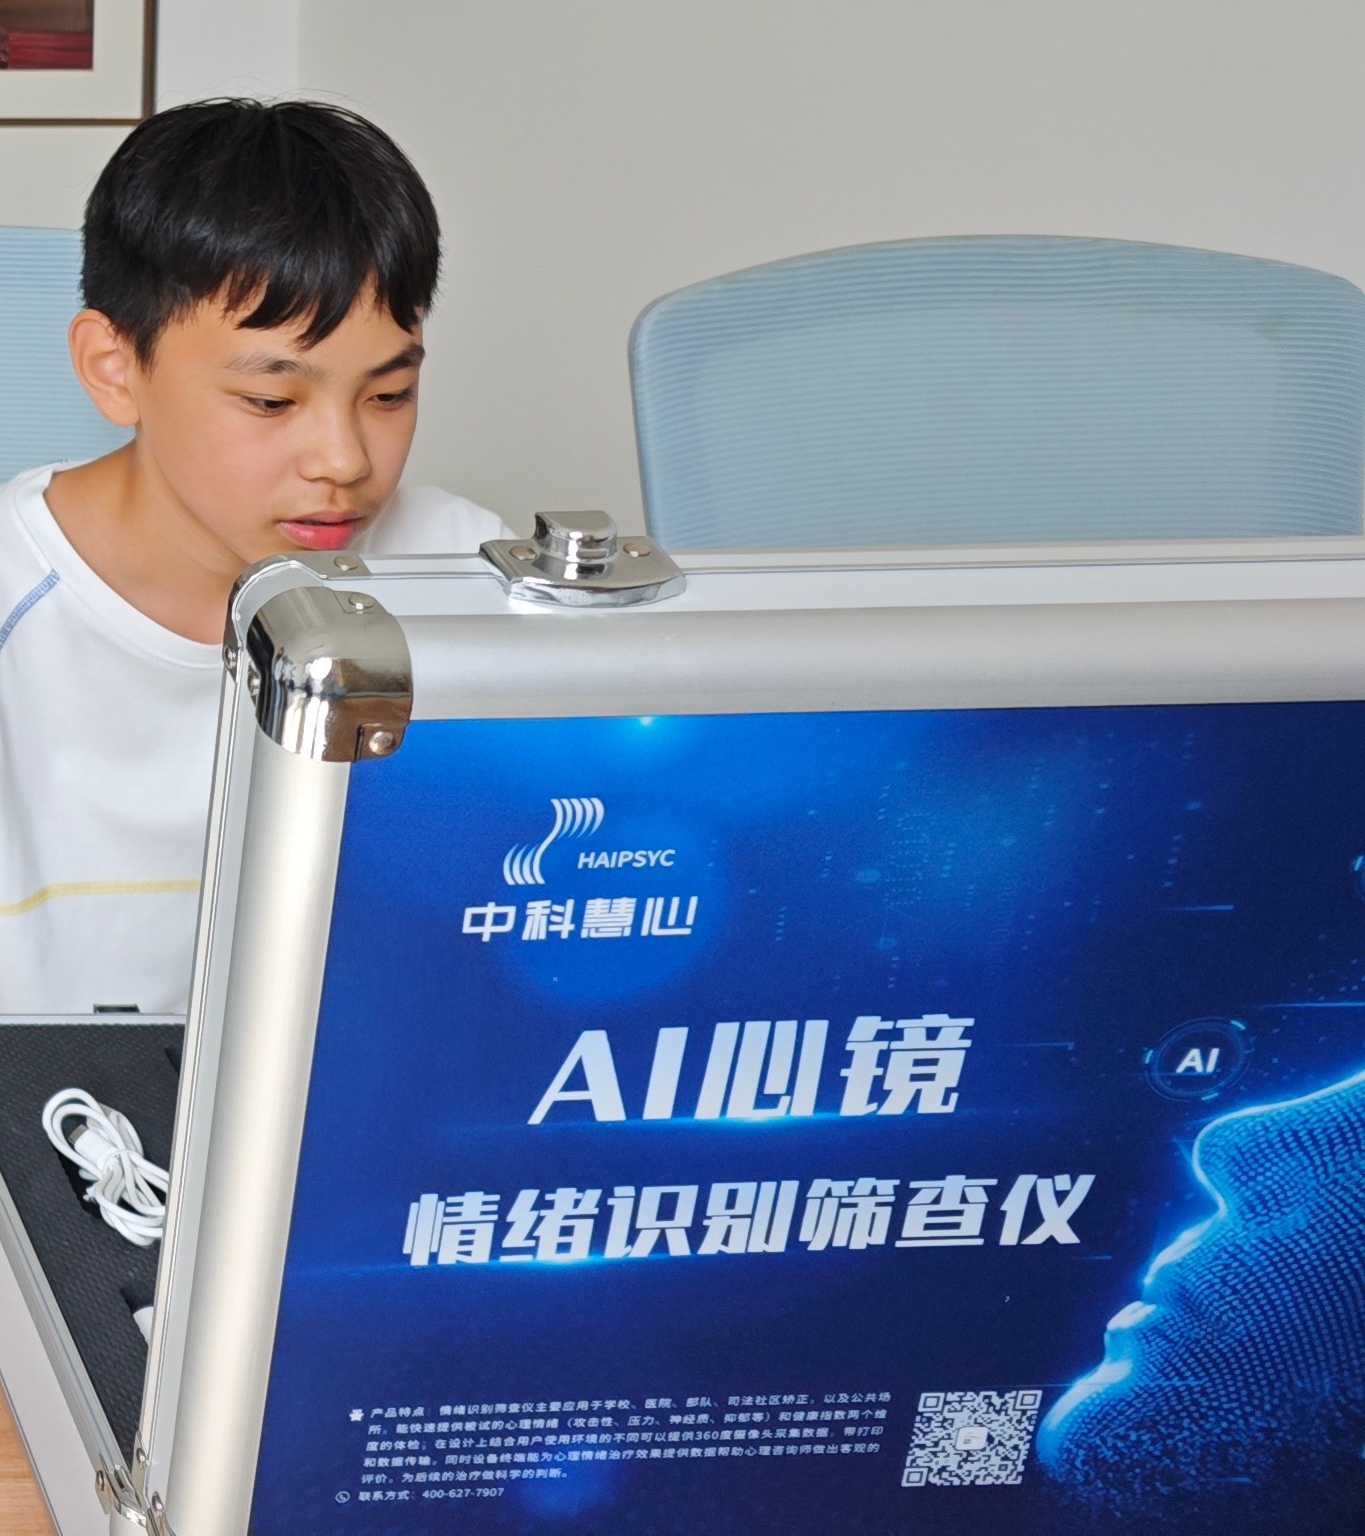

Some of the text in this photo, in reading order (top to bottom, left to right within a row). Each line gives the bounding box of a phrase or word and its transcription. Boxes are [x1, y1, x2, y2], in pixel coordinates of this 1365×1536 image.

[577, 849, 676, 869] HAIPSYC
[462, 896, 699, 943] 中科慧心
[527, 1013, 976, 1125] AI心镜
[1176, 1048, 1220, 1074] AI
[402, 1173, 1096, 1267] 情绪识别筛查仪
